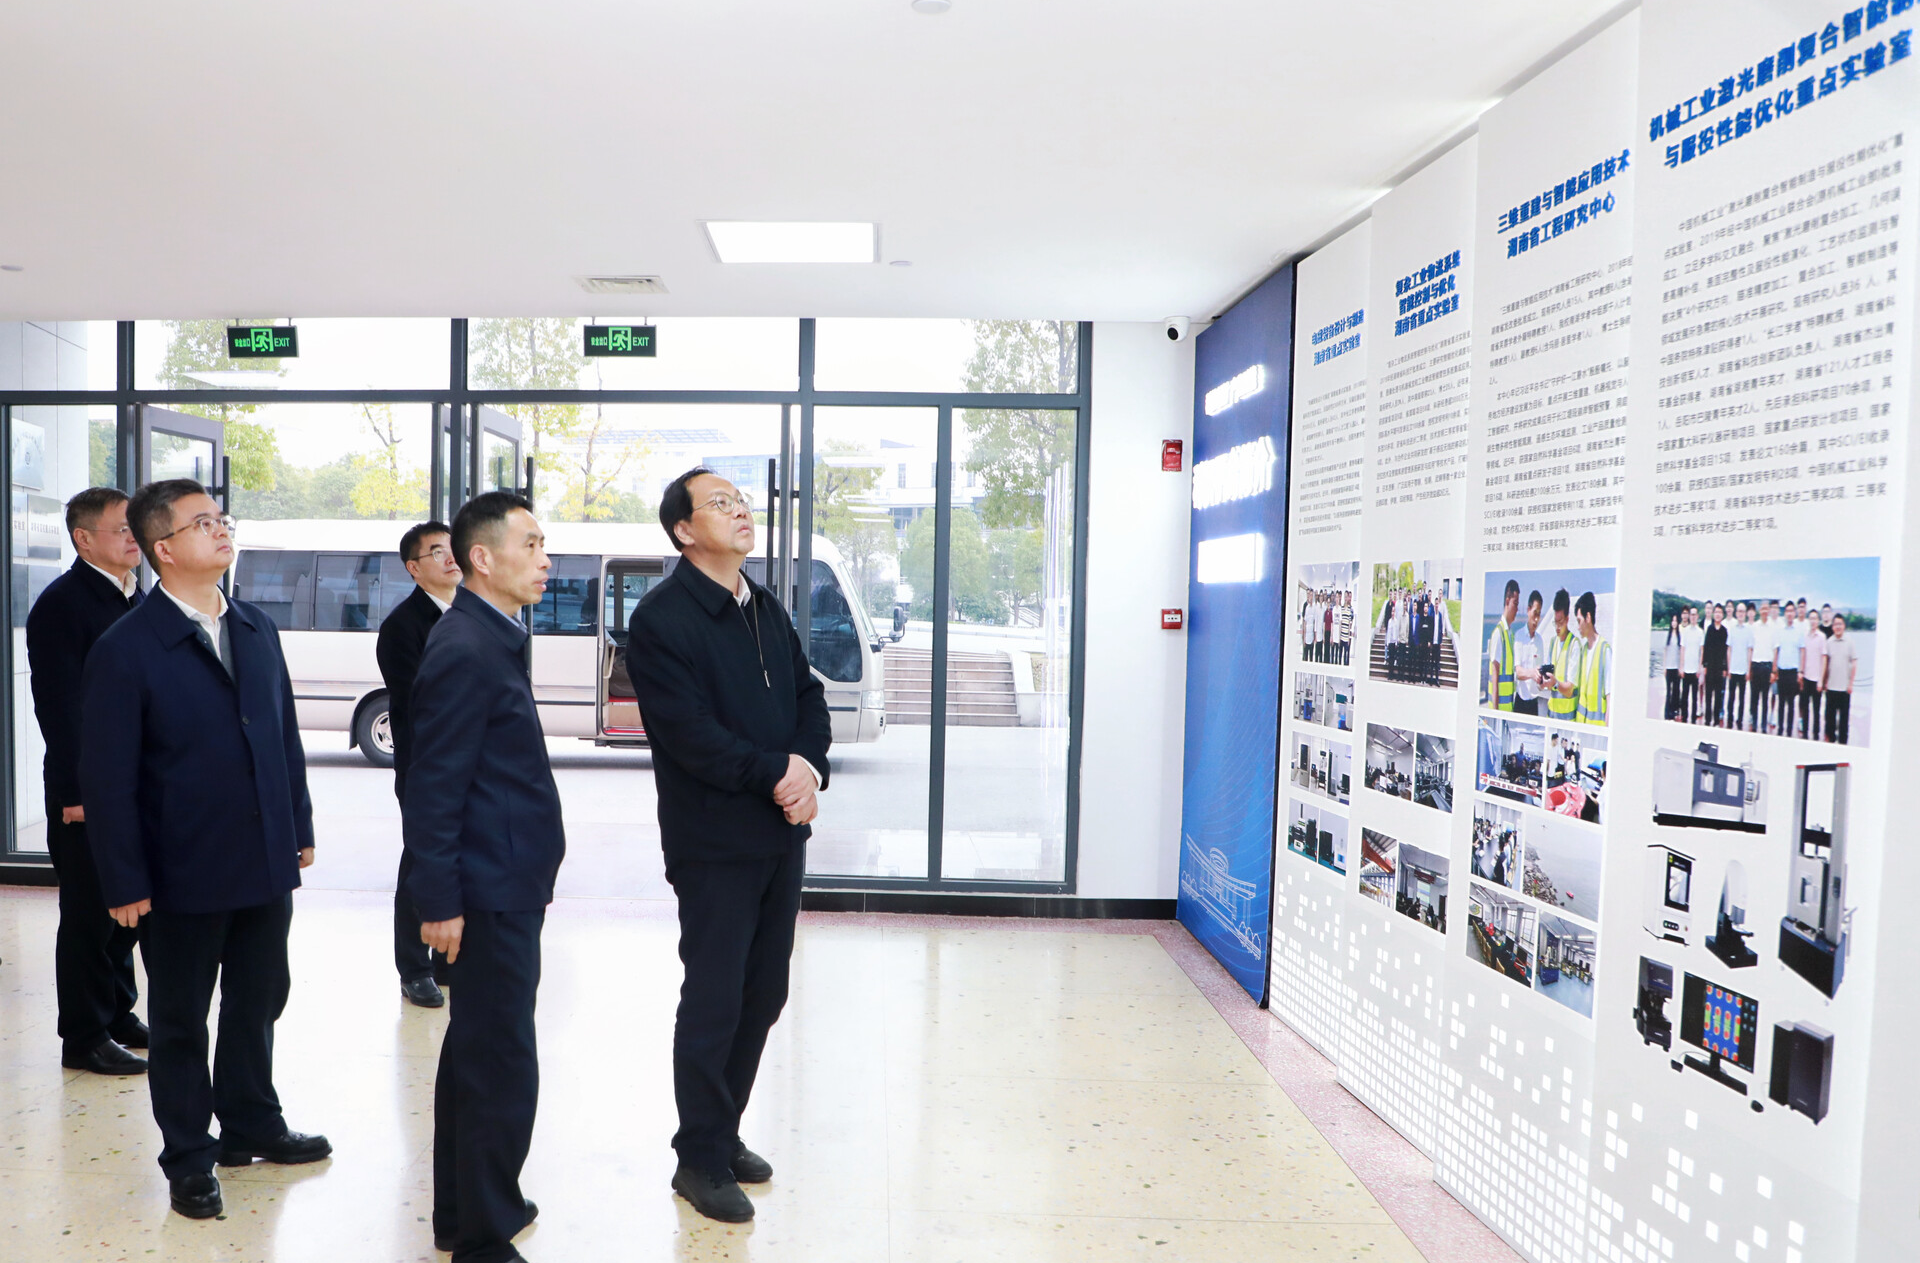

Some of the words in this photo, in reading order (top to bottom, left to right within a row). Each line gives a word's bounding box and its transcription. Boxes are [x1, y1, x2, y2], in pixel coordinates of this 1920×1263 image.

[1664, 28, 1913, 168] 与服役性能优化重点实验室
[1497, 148, 1631, 234] 三维重建与智能应用技术
[1507, 191, 1616, 259] 湖南省工程研究中心
[1395, 249, 1461, 297] 复杂工业物流系统
[1399, 273, 1455, 316] 智能控制与优化
[1394, 293, 1460, 337] 湖南省重点实验室
[274, 337, 290, 347] EXIT
[632, 336, 650, 346] EXIT
[1313, 332, 1361, 366] 湖南省重点实验室
